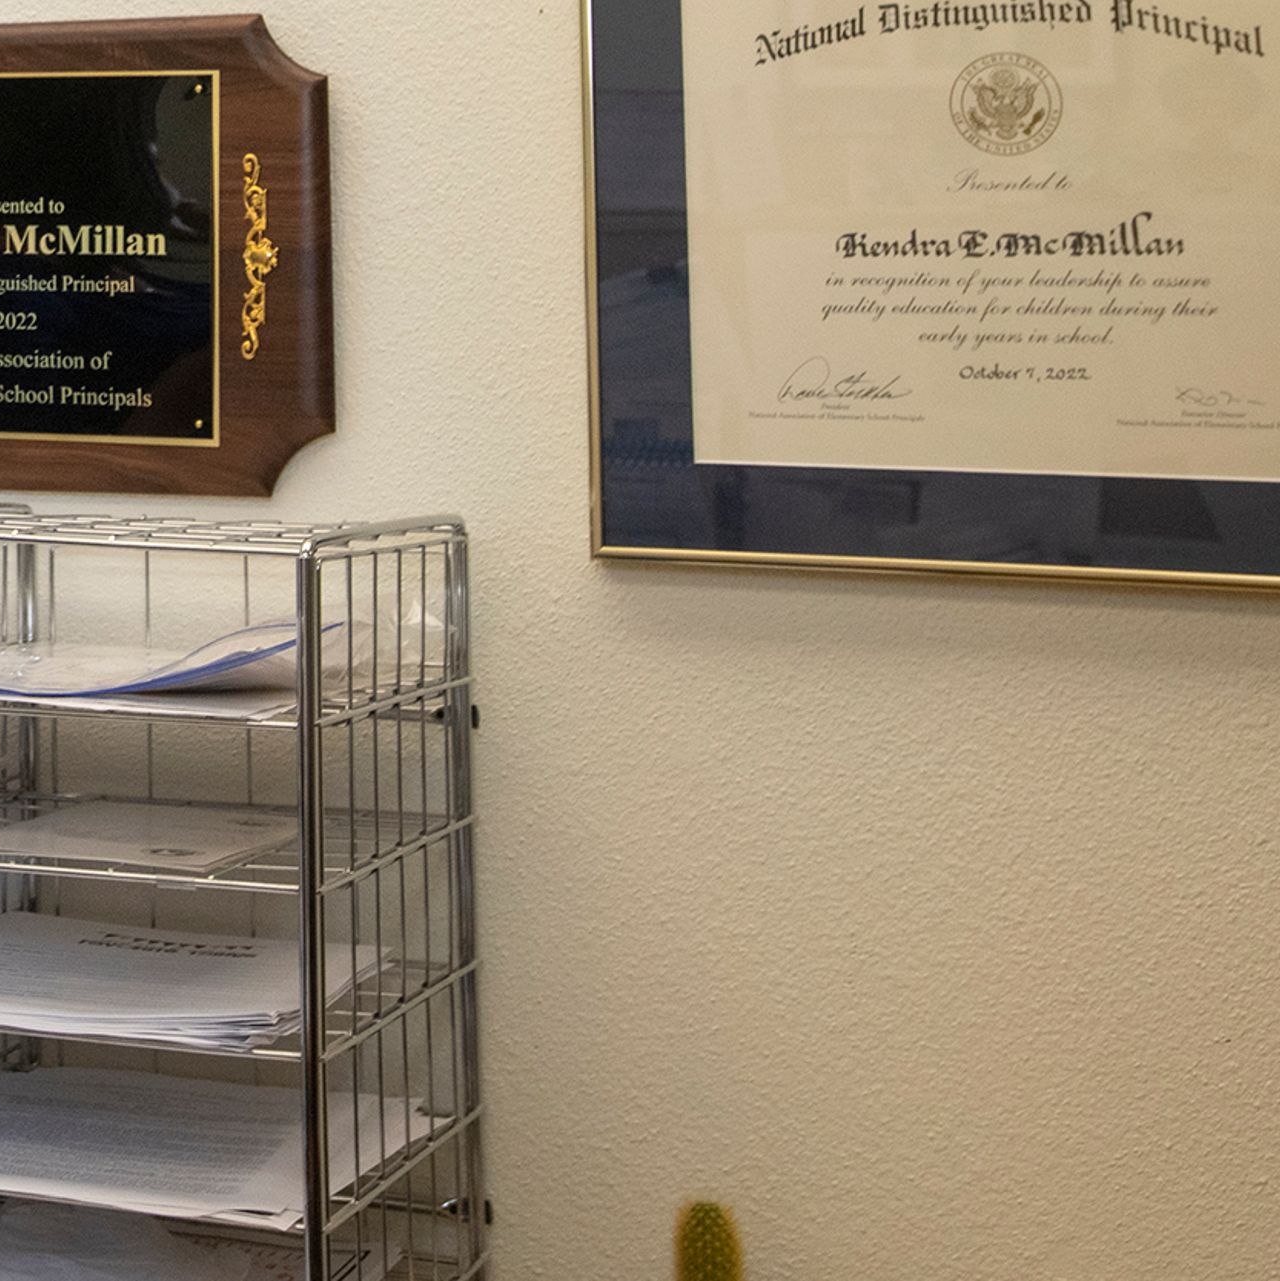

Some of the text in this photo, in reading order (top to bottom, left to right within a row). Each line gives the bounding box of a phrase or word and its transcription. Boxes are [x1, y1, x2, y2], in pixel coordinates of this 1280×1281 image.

[754, 4, 867, 67] National
[946, 168, 1074, 194] Presented to
[48, 198, 65, 214] to
[3, 224, 167, 256] McMillan
[835, 211, 1185, 259] Kendra E. McMillan
[62, 275, 136, 297] Principal
[825, 268, 1211, 295] in recognition of your leadership to assure
[821, 296, 1219, 324] quality education for children during their
[918, 325, 1114, 351] early years in school.
[90, 351, 113, 370] of
[958, 363, 1019, 381] October
[1044, 367, 1091, 381] 2022
[60, 386, 152, 411] Principals
